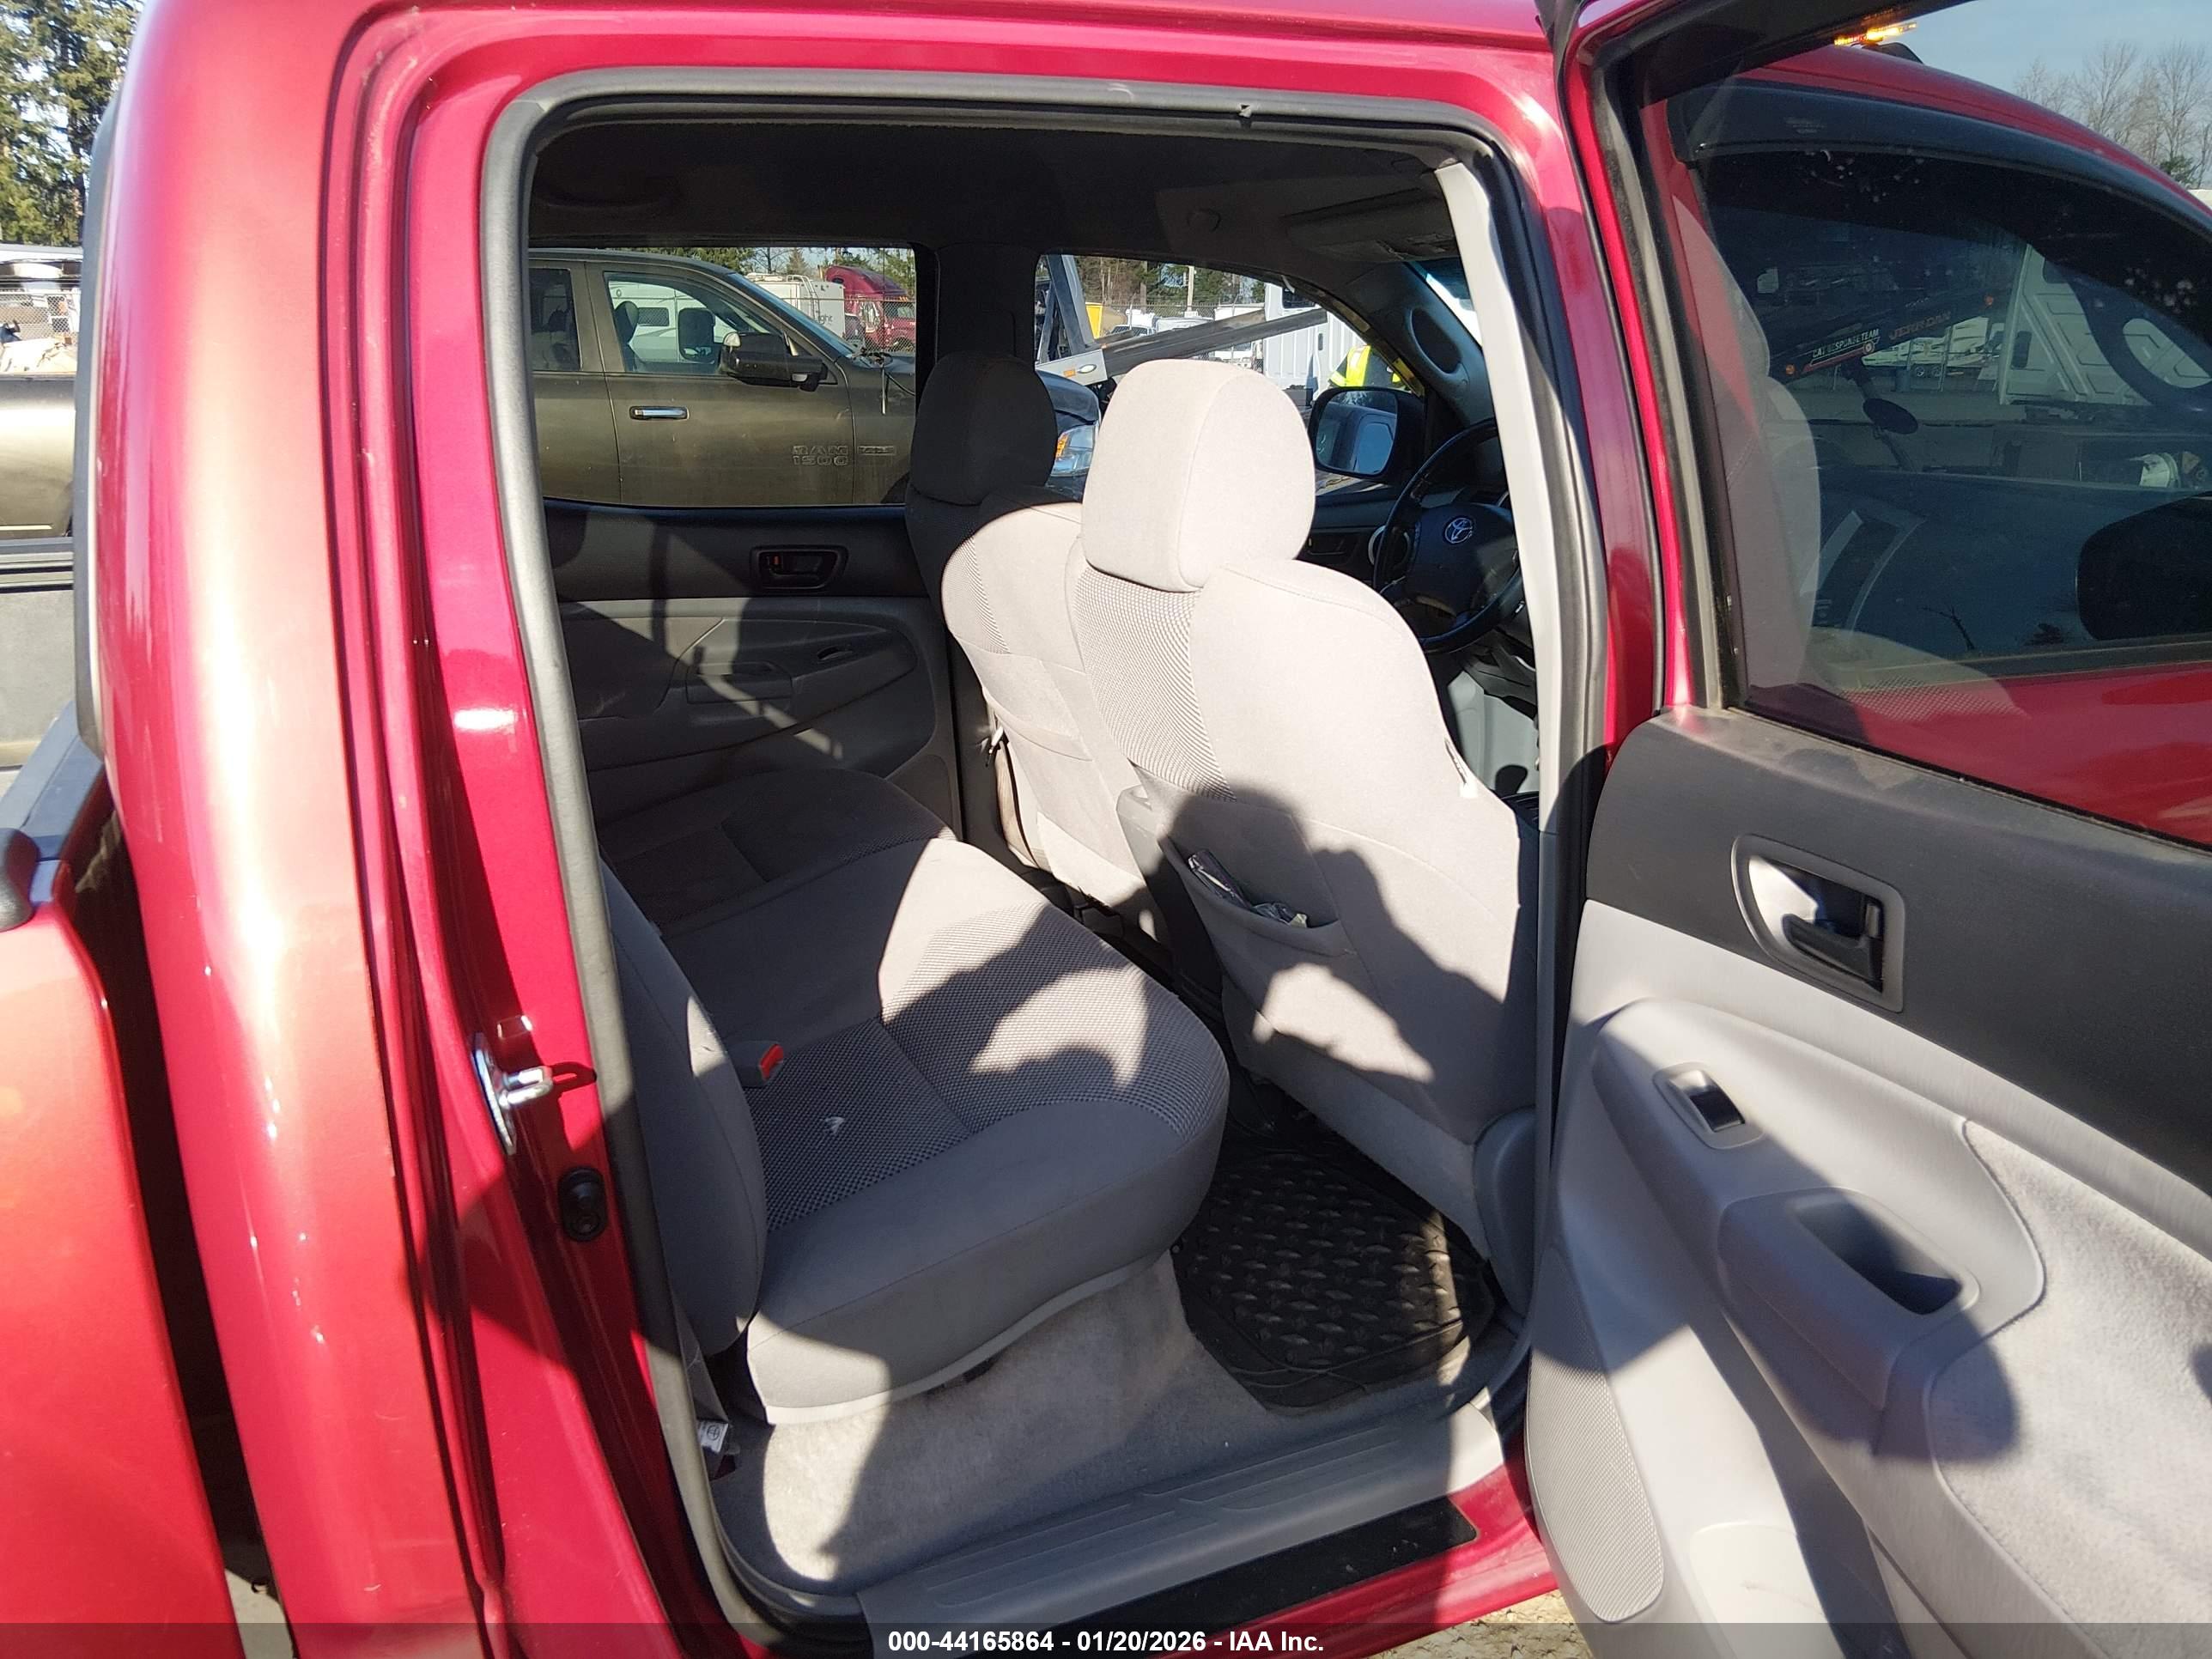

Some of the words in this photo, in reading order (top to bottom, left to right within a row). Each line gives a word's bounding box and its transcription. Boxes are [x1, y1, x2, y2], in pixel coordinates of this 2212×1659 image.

[1862, 328, 1880, 342] TEAM
[792, 445, 848, 456] RAM
[793, 455, 848, 465] 1500
